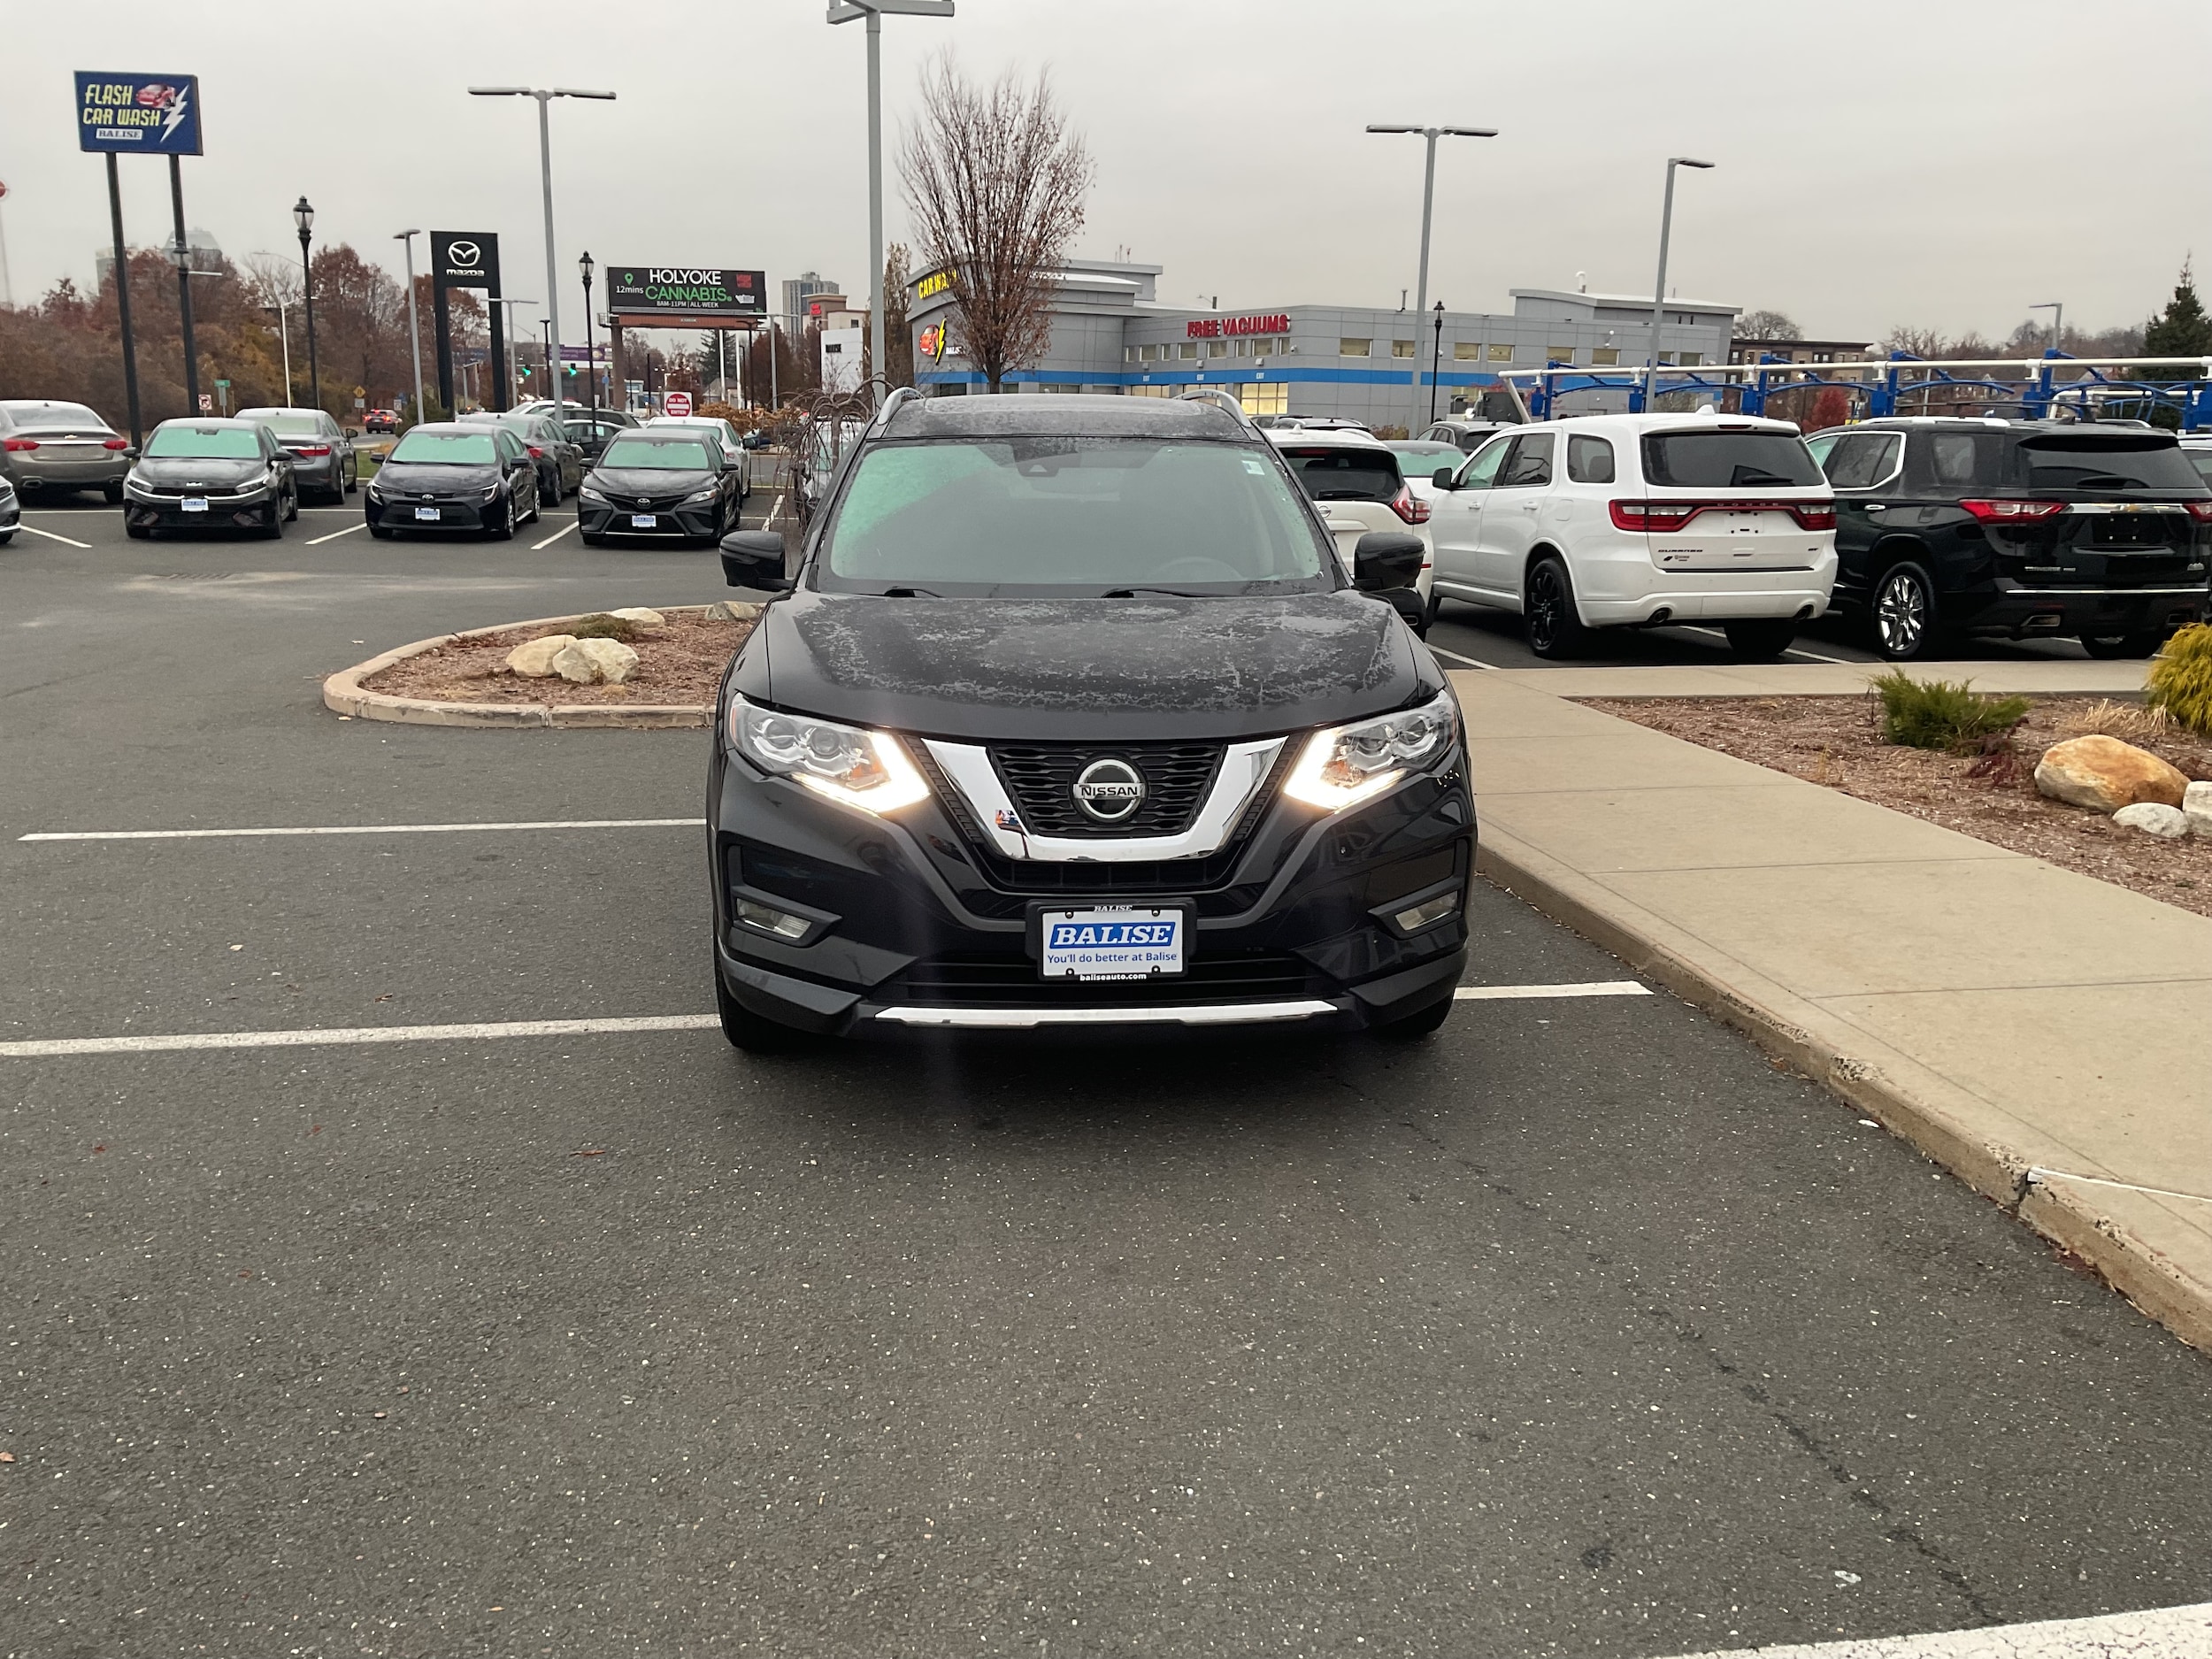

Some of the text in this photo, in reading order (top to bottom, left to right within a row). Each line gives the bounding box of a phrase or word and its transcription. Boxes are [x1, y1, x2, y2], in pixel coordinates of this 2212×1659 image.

[85, 83, 134, 105] FLASH
[82, 107, 161, 127] CAR WASH
[97, 129, 142, 139] BALISE
[446, 268, 485, 277] mazda
[649, 268, 722, 285] HOLYOKE
[616, 285, 644, 295] 12mins
[918, 277, 933, 299] CAR
[1187, 314, 1291, 337] FREE VACUUMS
[1080, 786, 1138, 796] NISSAN
[1094, 904, 1133, 913] BALISE
[1053, 925, 1171, 946] BALISE
[1047, 951, 1178, 964] You'll do better at Balise
[1079, 973, 1148, 982] baliseauto.com
